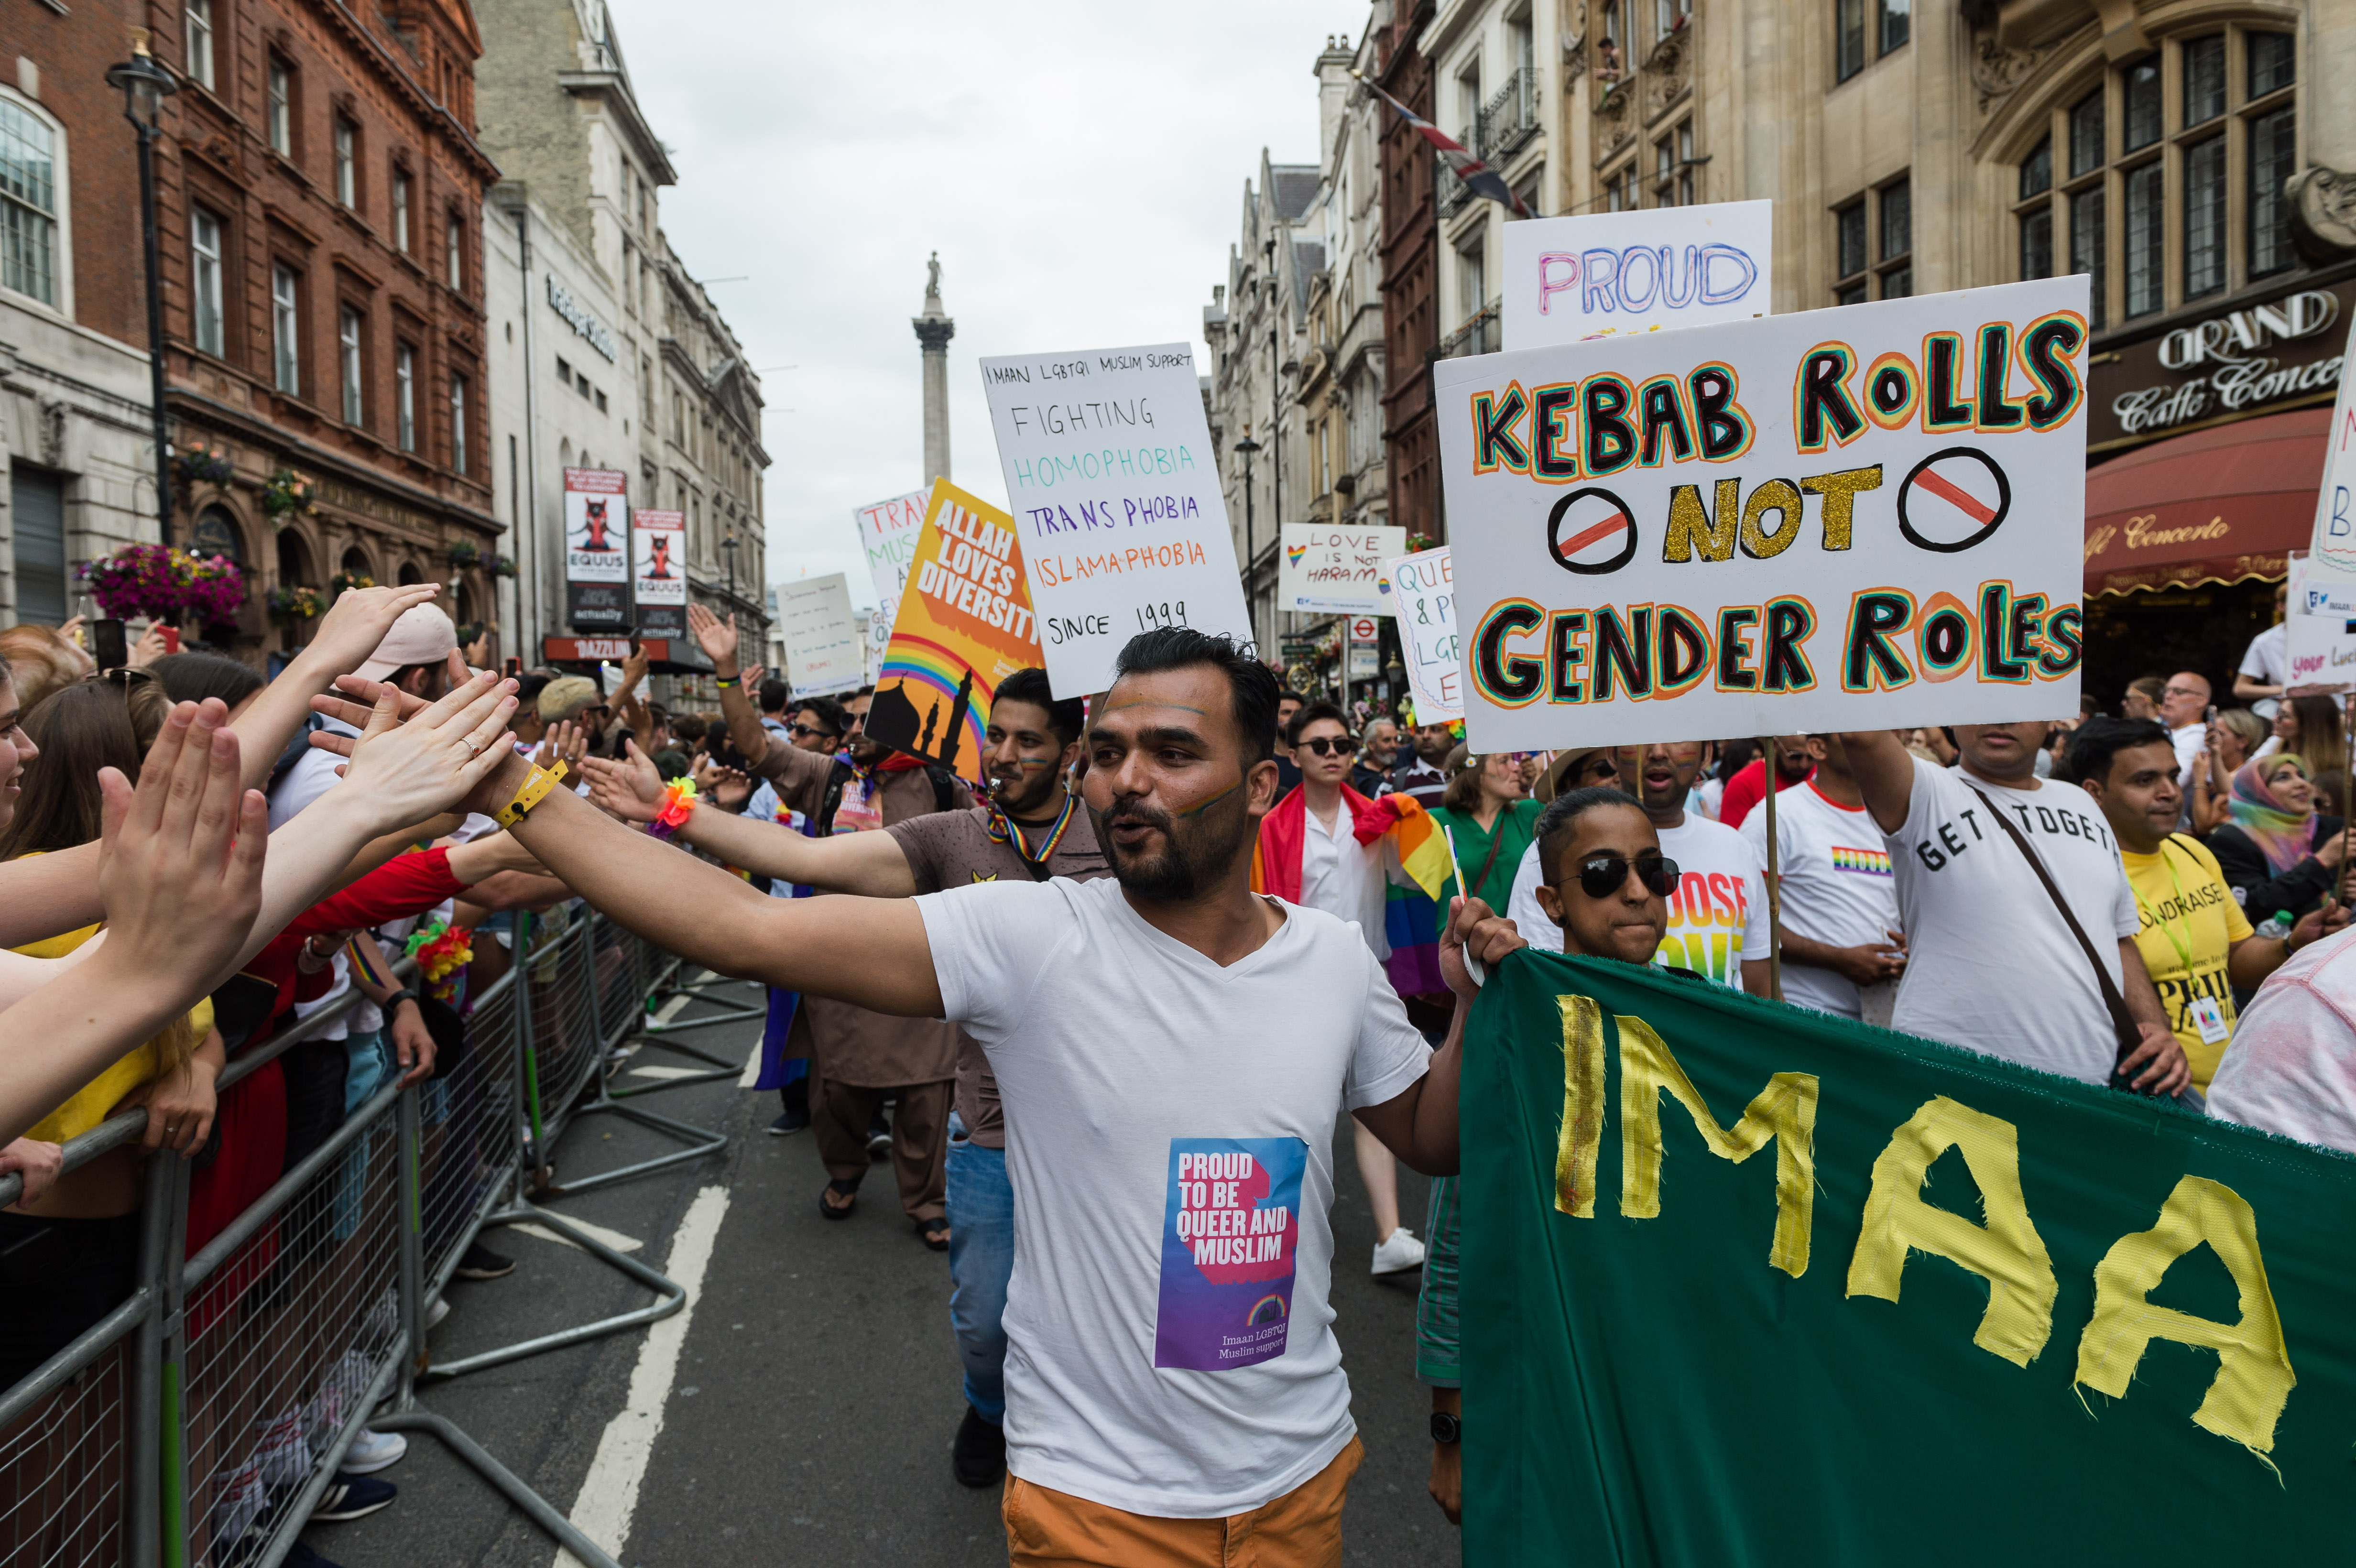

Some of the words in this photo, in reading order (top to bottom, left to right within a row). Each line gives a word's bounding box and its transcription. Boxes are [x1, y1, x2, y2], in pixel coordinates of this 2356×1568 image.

[1538, 243, 1758, 315] PROUD
[2158, 291, 2335, 369] GRAND
[986, 365, 1030, 384] IMAAN
[1040, 361, 1090, 381] LGBTQI
[1100, 355, 1142, 372] MUSLIM
[1147, 353, 1192, 369] SUPPORT
[2212, 357, 2344, 409] Conce
[1471, 361, 1756, 485] KEBAB
[1793, 310, 2088, 454] ROLLS
[1012, 398, 1155, 436] FIGHTING
[1014, 445, 1195, 488] HOMOPHOBIA
[864, 493, 929, 534] TRAN
[934, 498, 1014, 562] ALLAH
[1663, 463, 1883, 563] NOT
[868, 533, 917, 569] MUS
[1310, 532, 1380, 551] LOVE
[1325, 553, 1341, 563] IS
[1354, 555, 1381, 566] NOT
[570, 554, 623, 567] EQUUS
[937, 534, 1016, 597] LOVES
[1034, 540, 1206, 588] ISLAMAPHOBIA
[1307, 566, 1377, 582] HARAM
[1398, 556, 1453, 592] QUE
[916, 559, 1040, 645] DIVERSITY
[1047, 615, 1110, 644] SINCE
[1136, 600, 1189, 631] 1999
[575, 640, 631, 659] 'DAZZLIN
[1418, 634, 1460, 666] LGB
[1469, 594, 1818, 710] GENDER
[1841, 579, 2082, 694] ROLES
[2292, 654, 2325, 680] your
[1917, 809, 1983, 872] GET
[2012, 805, 2121, 873] TOGETH
[1840, 849, 1887, 873] PROUD
[1178, 1153, 1253, 1180] PROUD
[1178, 1181, 1207, 1209] TO
[1212, 1181, 1240, 1209] BE
[1177, 1209, 1246, 1242] QUEER
[1250, 1206, 1287, 1235] AND
[1194, 1234, 1282, 1266] MUSLIM
[1219, 1347, 1254, 1360] Muslim
[1256, 1336, 1284, 1354] support
[1222, 1334, 1254, 1346] Imaan
[1255, 1323, 1286, 1341] LGBTQI
